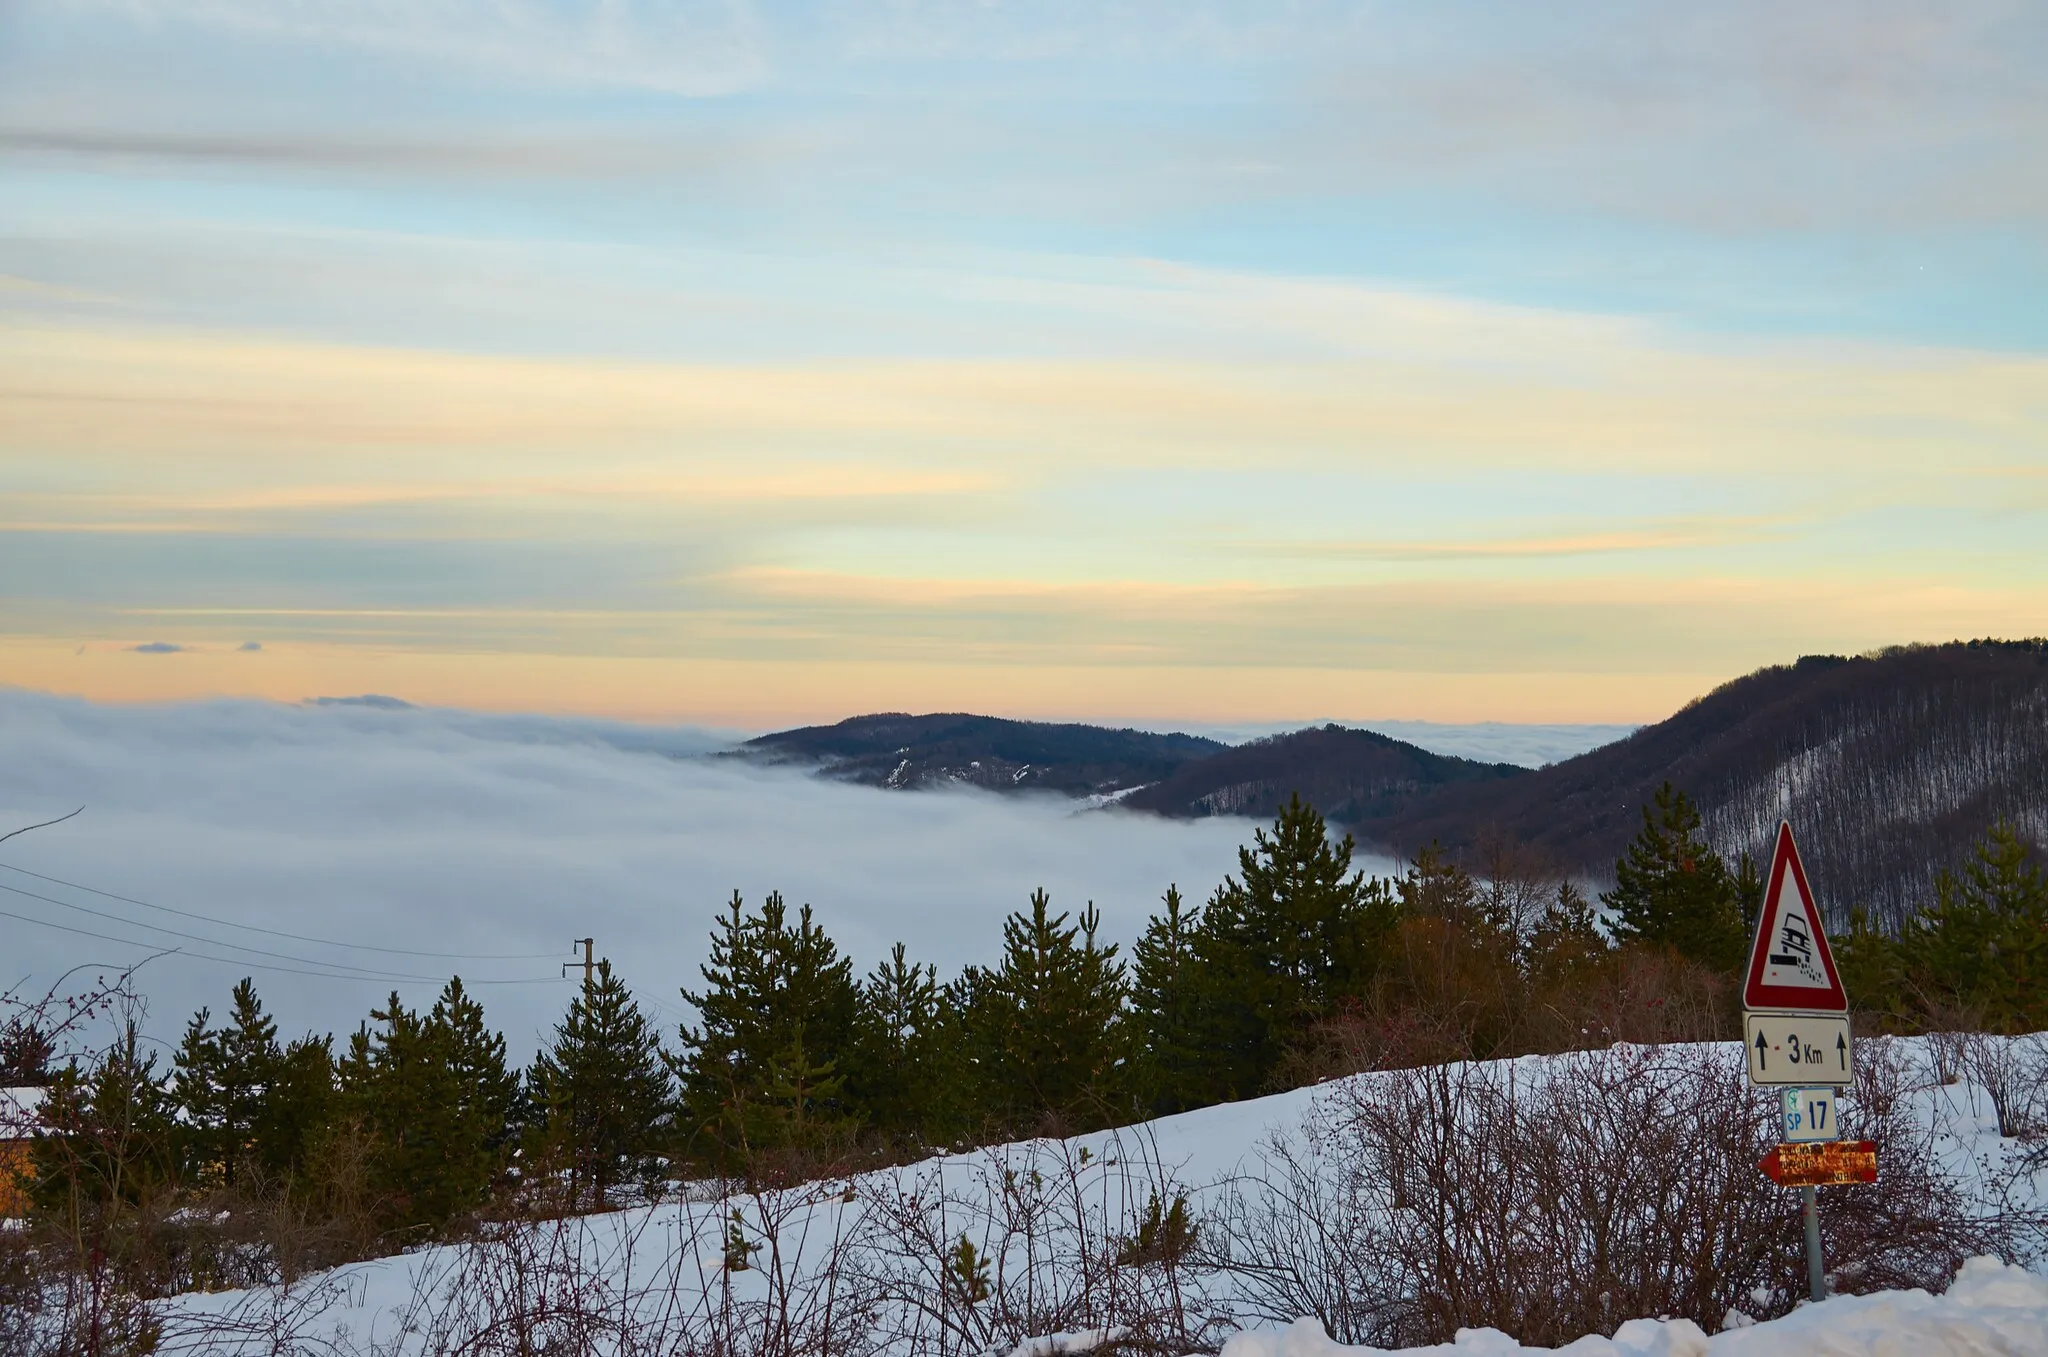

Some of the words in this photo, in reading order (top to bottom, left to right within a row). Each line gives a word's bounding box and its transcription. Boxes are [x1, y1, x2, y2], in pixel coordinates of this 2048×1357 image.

[1788, 1034, 1801, 1064] 3
[1804, 1044, 1823, 1064] Km
[1787, 1113, 1801, 1131] SP
[1809, 1101, 1827, 1130] 17
